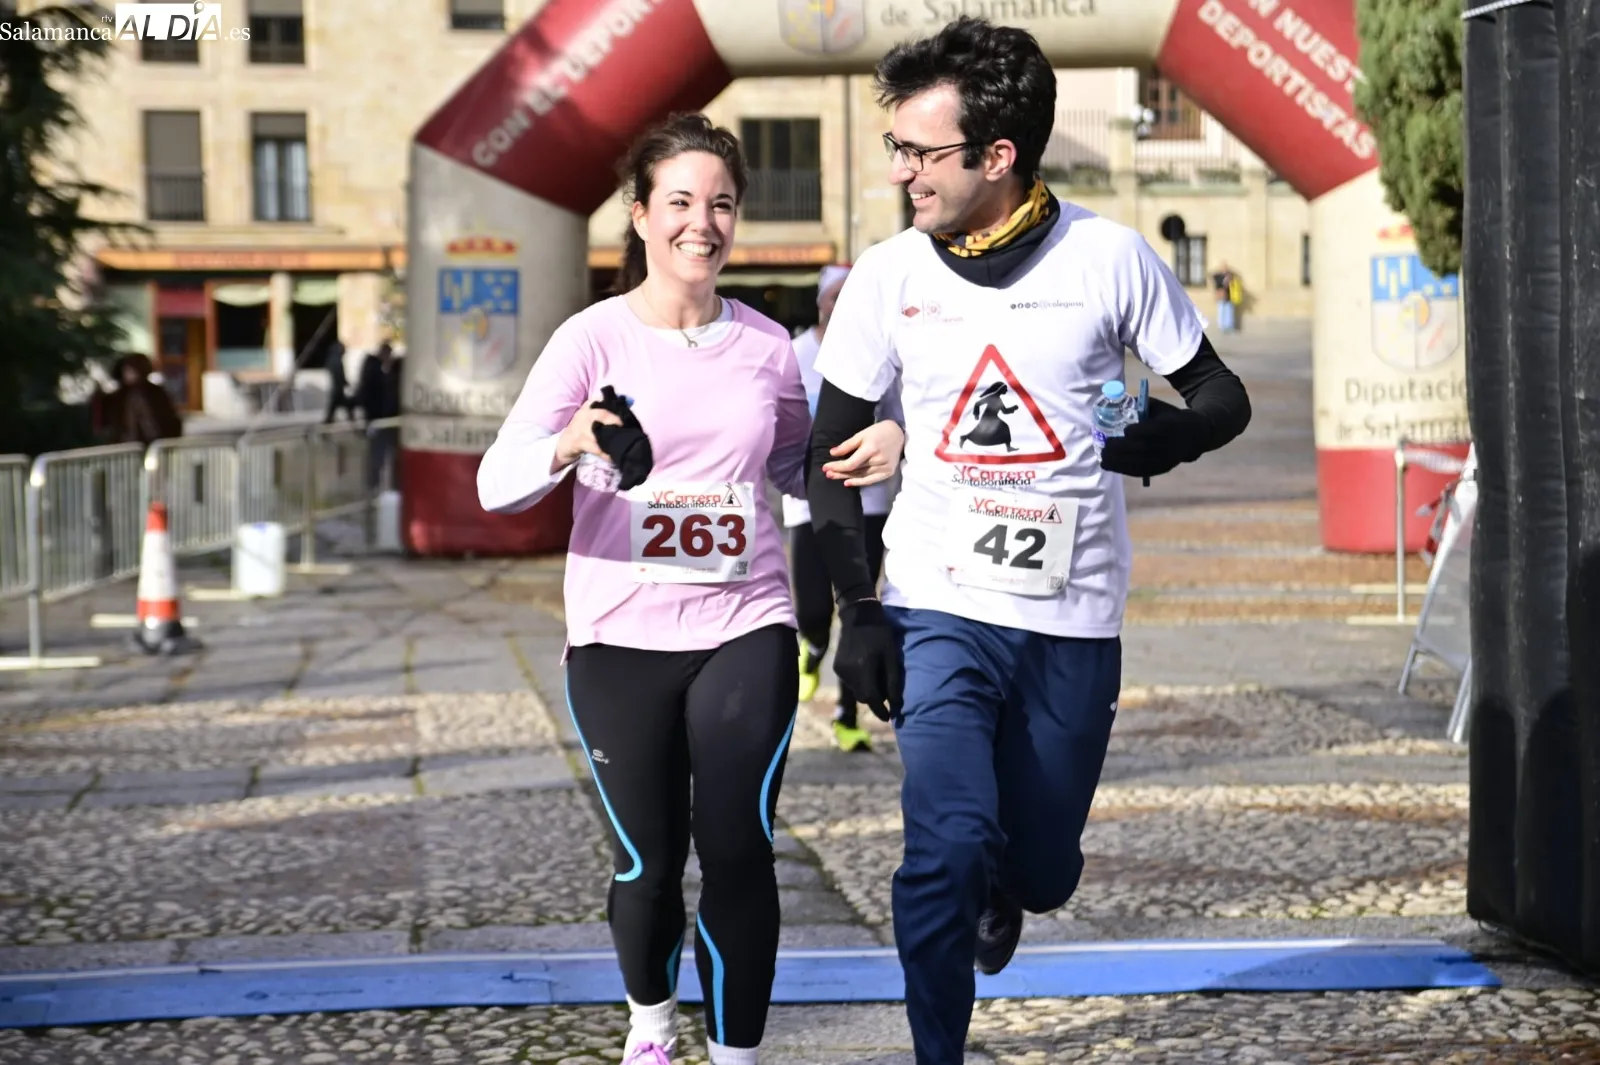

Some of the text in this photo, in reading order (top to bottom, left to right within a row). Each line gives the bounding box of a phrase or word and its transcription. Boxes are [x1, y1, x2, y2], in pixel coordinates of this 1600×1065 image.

[880, 0, 1095, 26] de Salamanca
[1198, 0, 1378, 160] DEPORTISTAS
[472, 109, 531, 167] CON
[642, 513, 746, 557] 263
[973, 523, 1046, 570] 42
